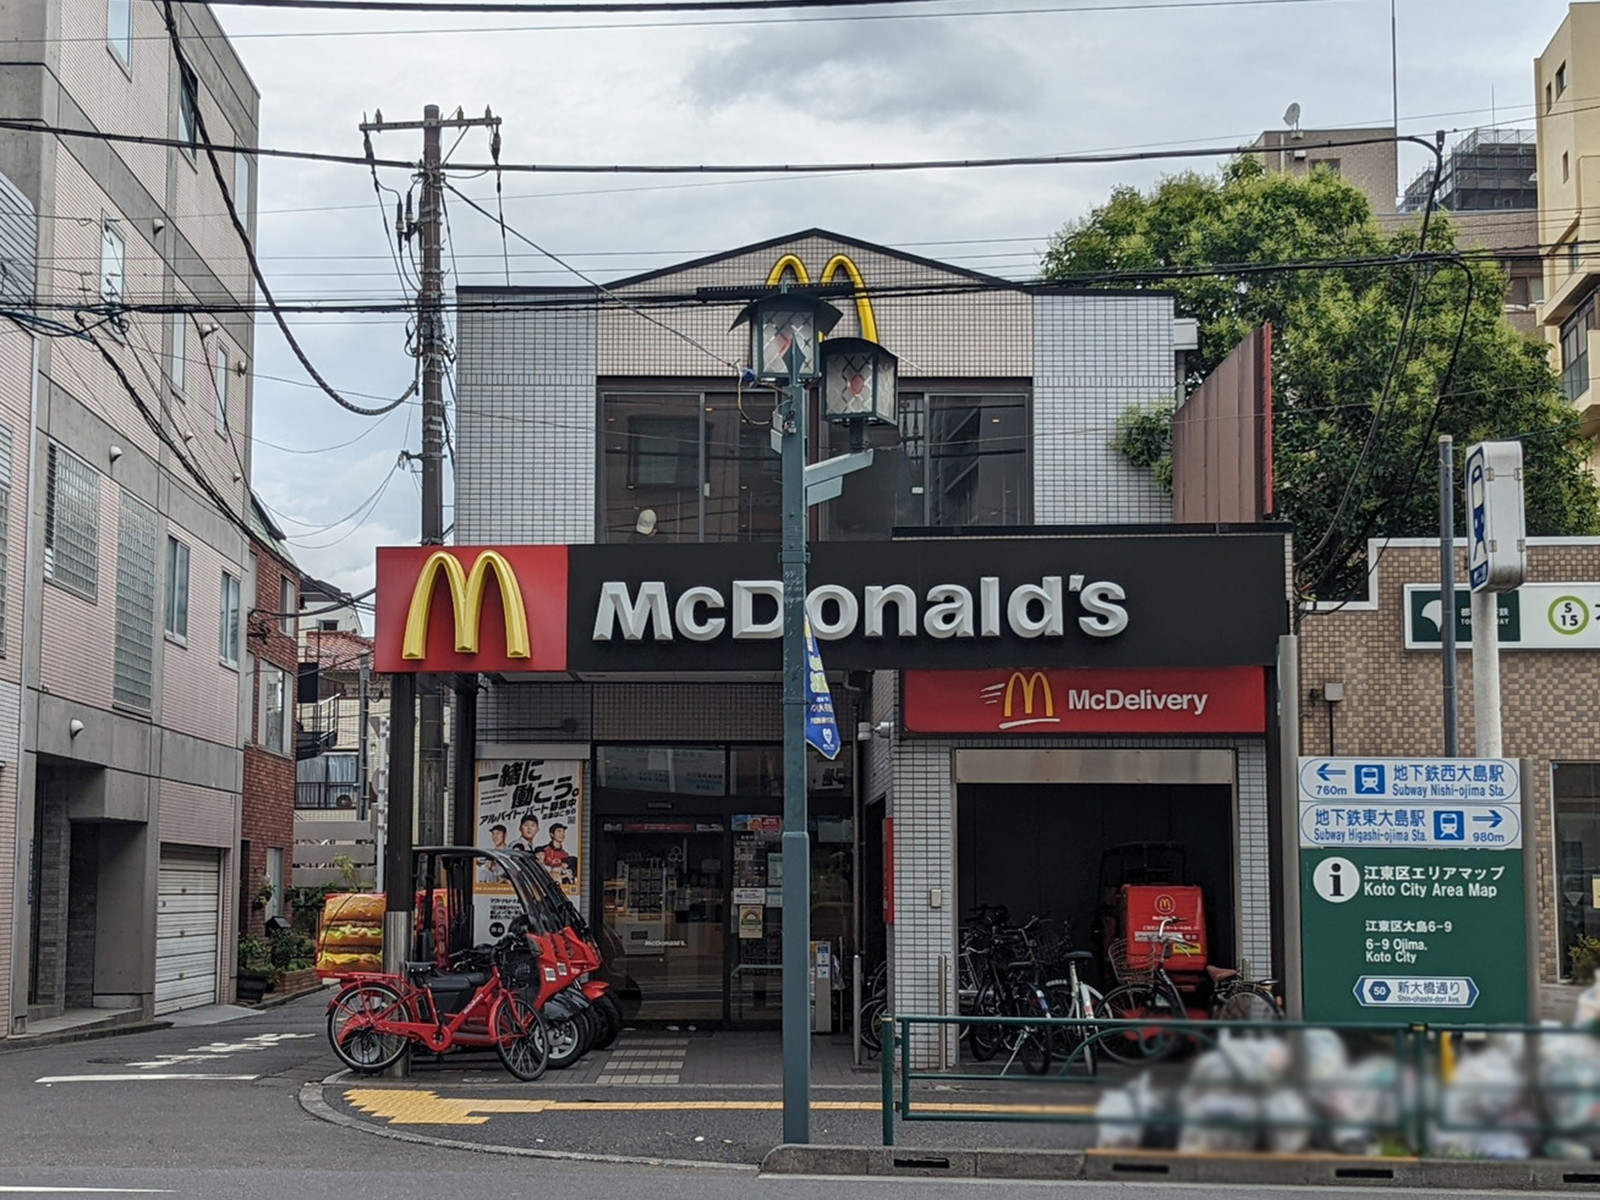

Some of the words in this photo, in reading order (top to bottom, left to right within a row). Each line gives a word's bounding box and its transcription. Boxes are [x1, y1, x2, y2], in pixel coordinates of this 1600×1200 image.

[592, 574, 1129, 641] McDonald's
[1561, 614, 1579, 627] 15
[1068, 689, 1208, 715] McDelivery
[1393, 764, 1505, 782] 地下鉄西大島駅
[1316, 785, 1347, 795] 760m
[1392, 783, 1427, 799] Subway
[1430, 784, 1486, 799] Nishi-ojima
[1314, 808, 1426, 827] 地下鉄東大島駅
[1314, 828, 1345, 842] Subway
[1348, 829, 1409, 843] Higashi-ojima
[1472, 832, 1505, 842] 980m
[1364, 865, 1505, 881] 江東区エリアマップ
[1364, 882, 1396, 896] Koto
[1400, 882, 1427, 898] City
[1432, 883, 1464, 897] Area
[1468, 883, 1498, 898] Map
[1365, 920, 1453, 932] 江東区大島6-9
[1365, 938, 1390, 950] 6-9
[1365, 951, 1392, 963] Koto
[1395, 951, 1417, 964] City
[1373, 986, 1387, 996] 50
[1398, 981, 1460, 995] 新大橋通り
